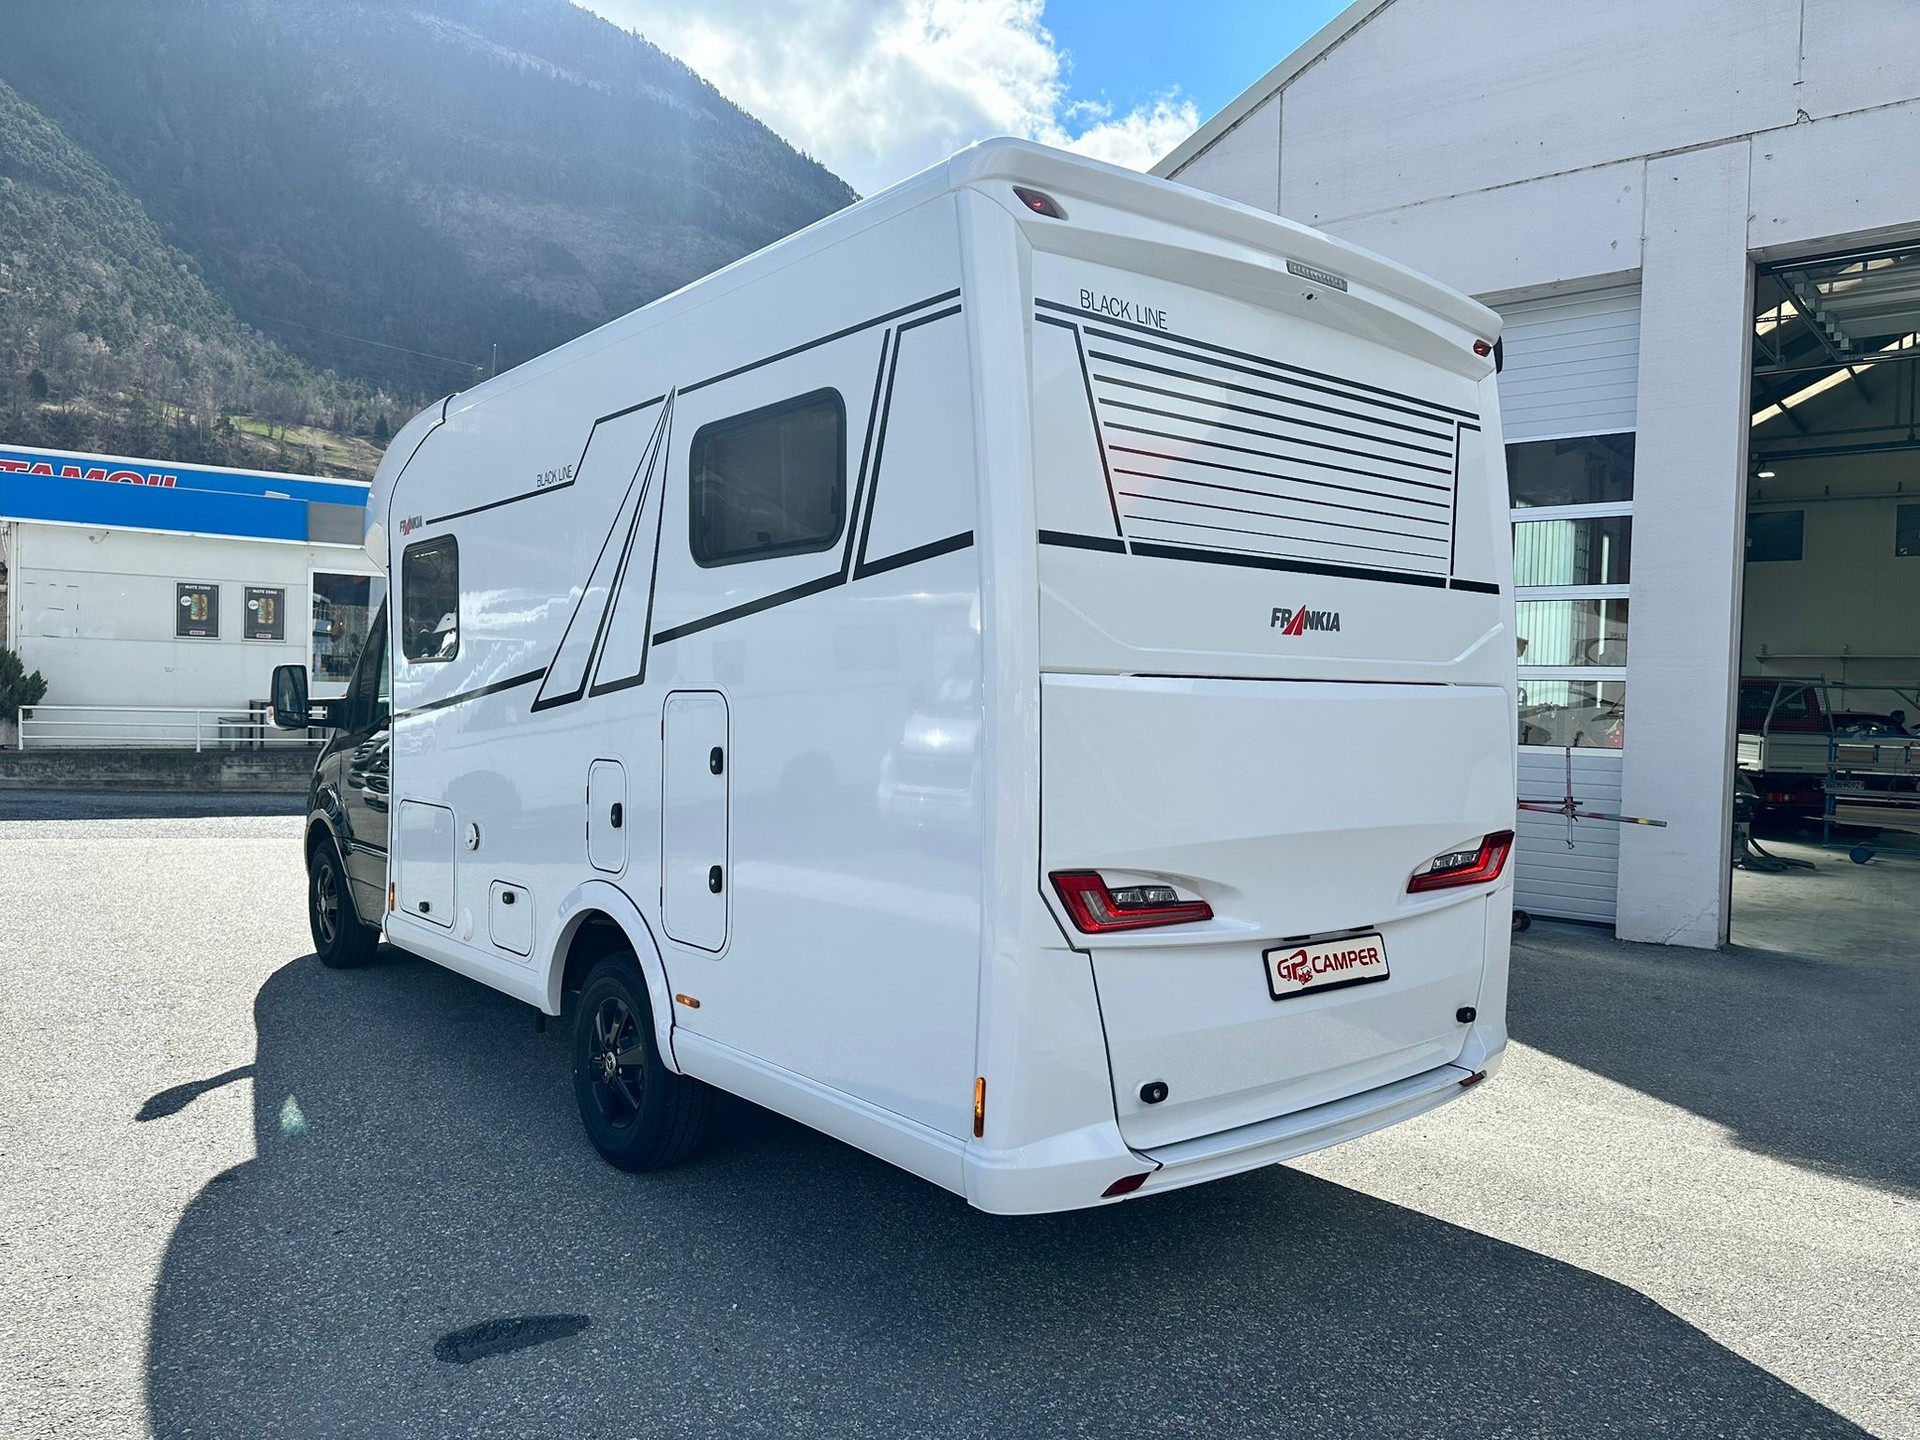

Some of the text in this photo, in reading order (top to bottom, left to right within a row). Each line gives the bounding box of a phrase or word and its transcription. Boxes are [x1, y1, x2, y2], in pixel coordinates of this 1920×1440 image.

[1080, 288, 1168, 331] BLACK LINE
[536, 464, 573, 488] BLACK LINE
[1270, 604, 1341, 636] FRANKIA
[1277, 947, 1381, 981] GP CAMPER
